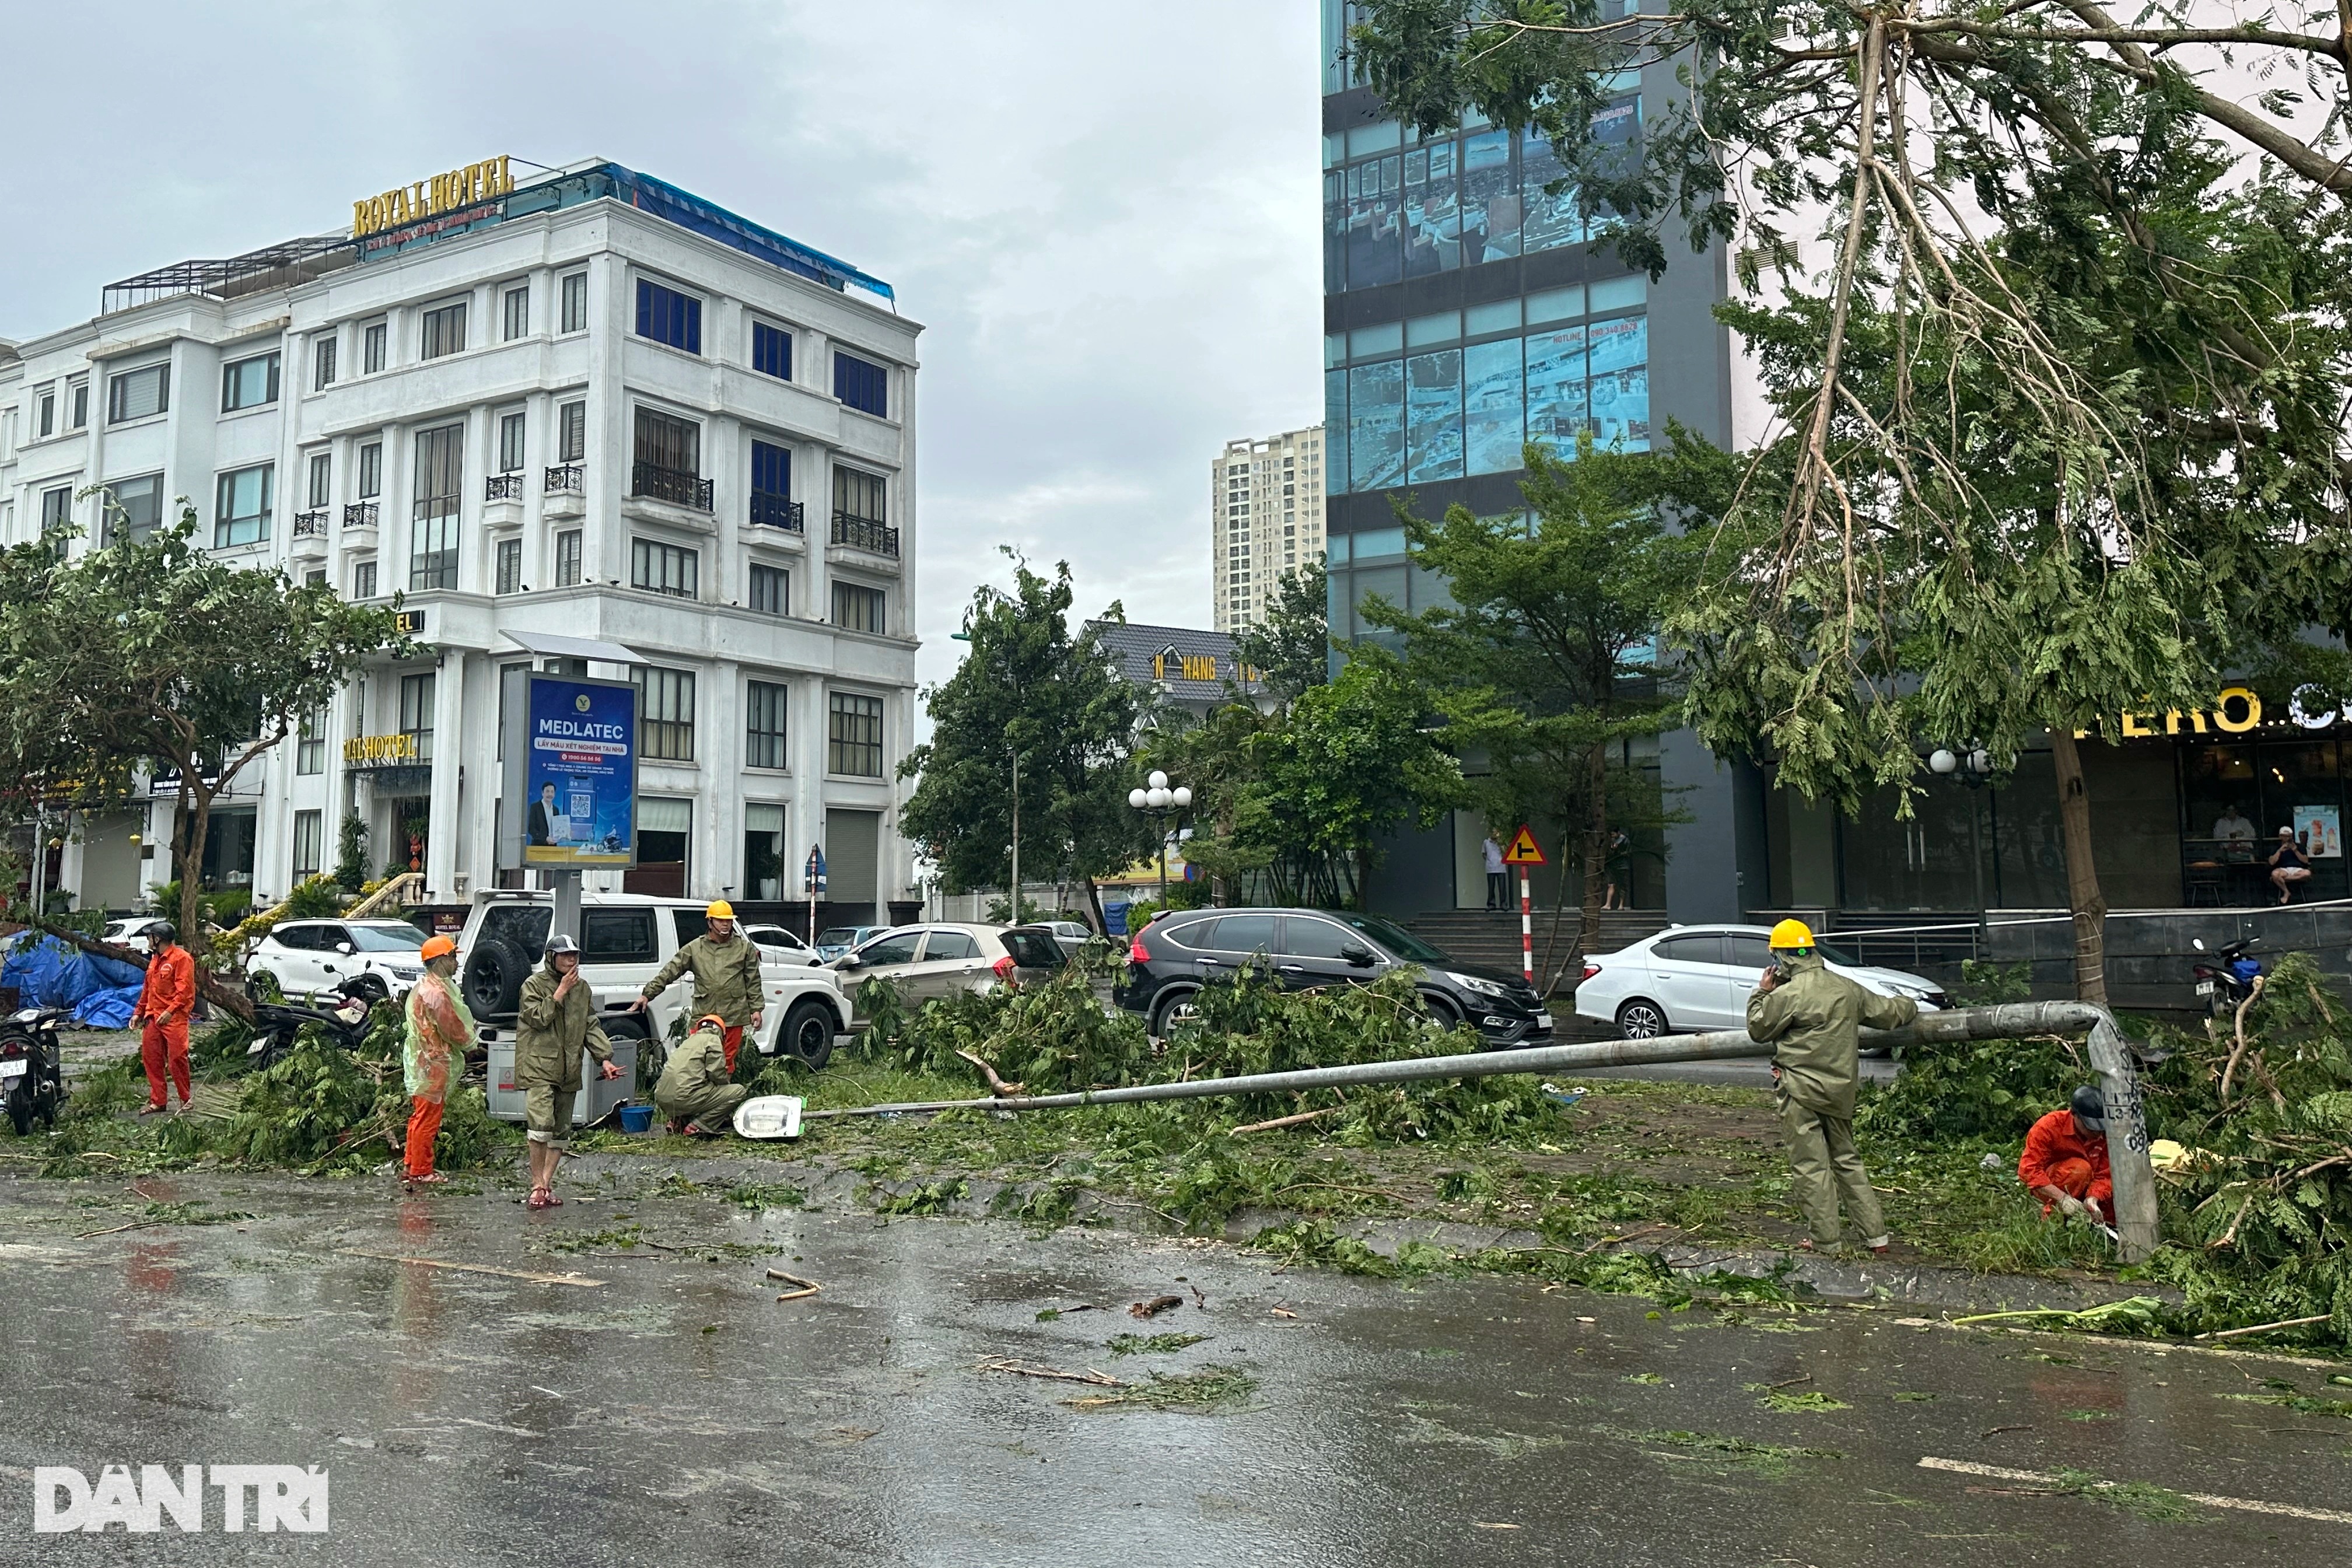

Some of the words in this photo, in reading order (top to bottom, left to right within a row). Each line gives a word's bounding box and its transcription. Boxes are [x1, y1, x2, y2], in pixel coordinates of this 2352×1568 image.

[353, 181, 428, 239] ROYAL
[430, 155, 514, 215] HOTEL
[539, 719, 624, 740] MEDLATEC
[365, 734, 416, 759] HOTEL
[537, 738, 550, 747] LẤY
[550, 740, 564, 748] MÁU
[565, 741, 578, 750] XÉT
[611, 745, 624, 753] NHÀ
